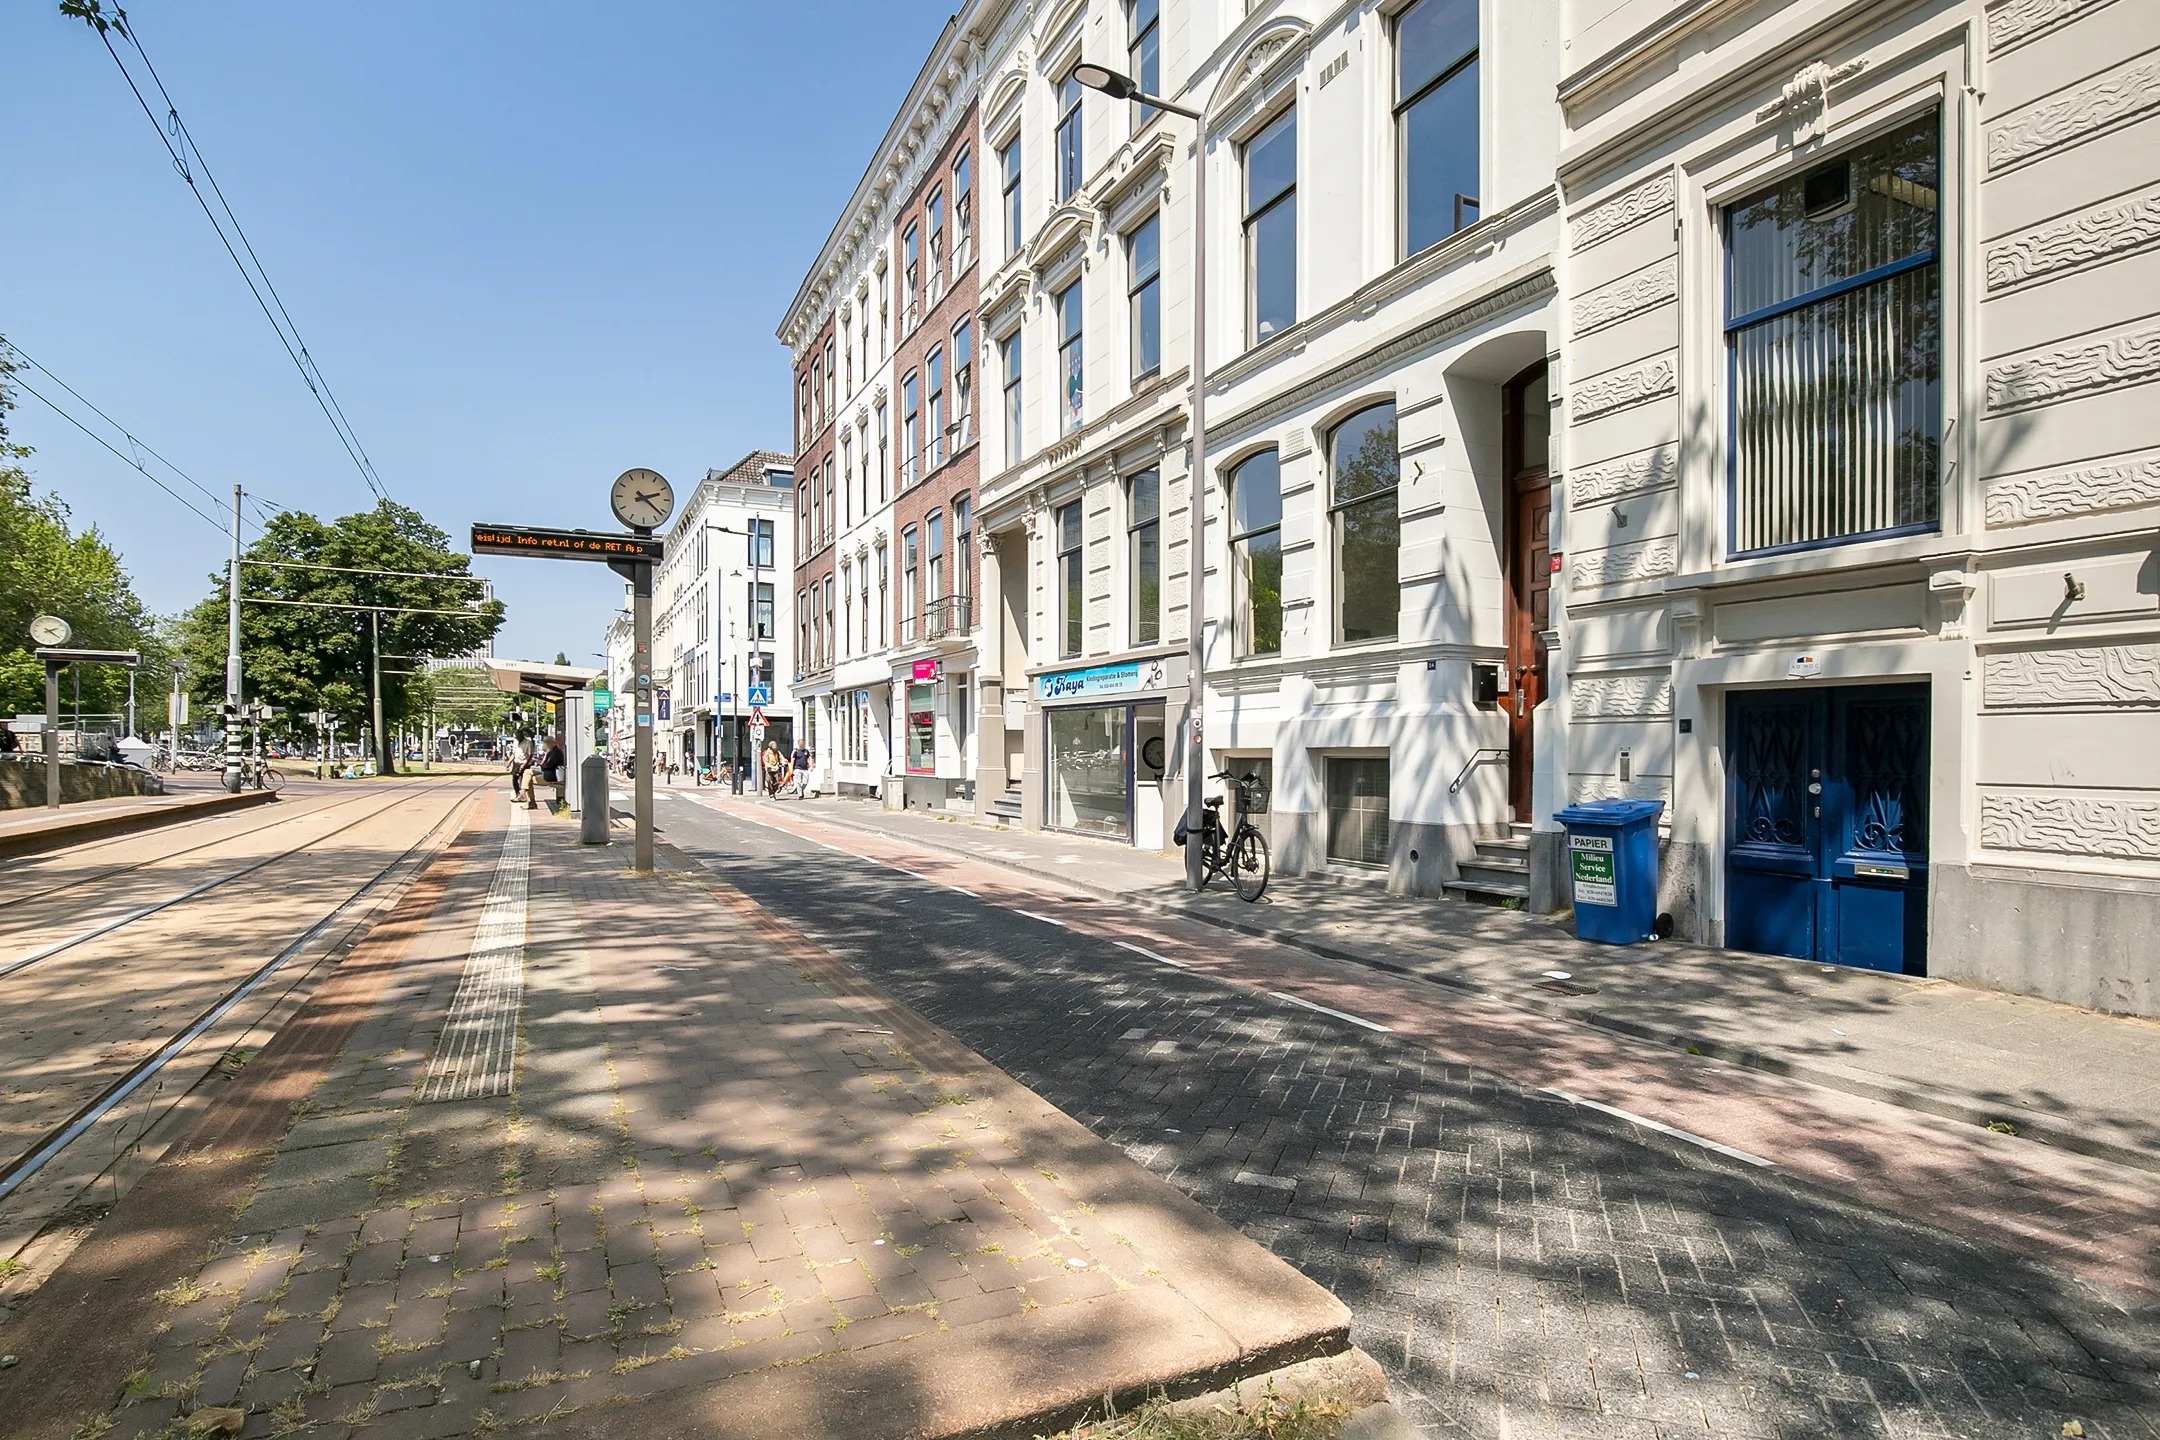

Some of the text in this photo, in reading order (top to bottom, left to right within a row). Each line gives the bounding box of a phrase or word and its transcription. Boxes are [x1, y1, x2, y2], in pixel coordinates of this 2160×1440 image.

[517, 536, 538, 545] Info
[541, 538, 570, 548] ret.nl
[573, 540, 585, 548] of
[605, 542, 622, 551] RET
[1054, 674, 1085, 695] Kaya
[1574, 838, 1608, 848] PAPIER
[1581, 853, 1604, 862] Milieu
[1580, 863, 1606, 872] Service
[1575, 872, 1612, 883] Nederland
